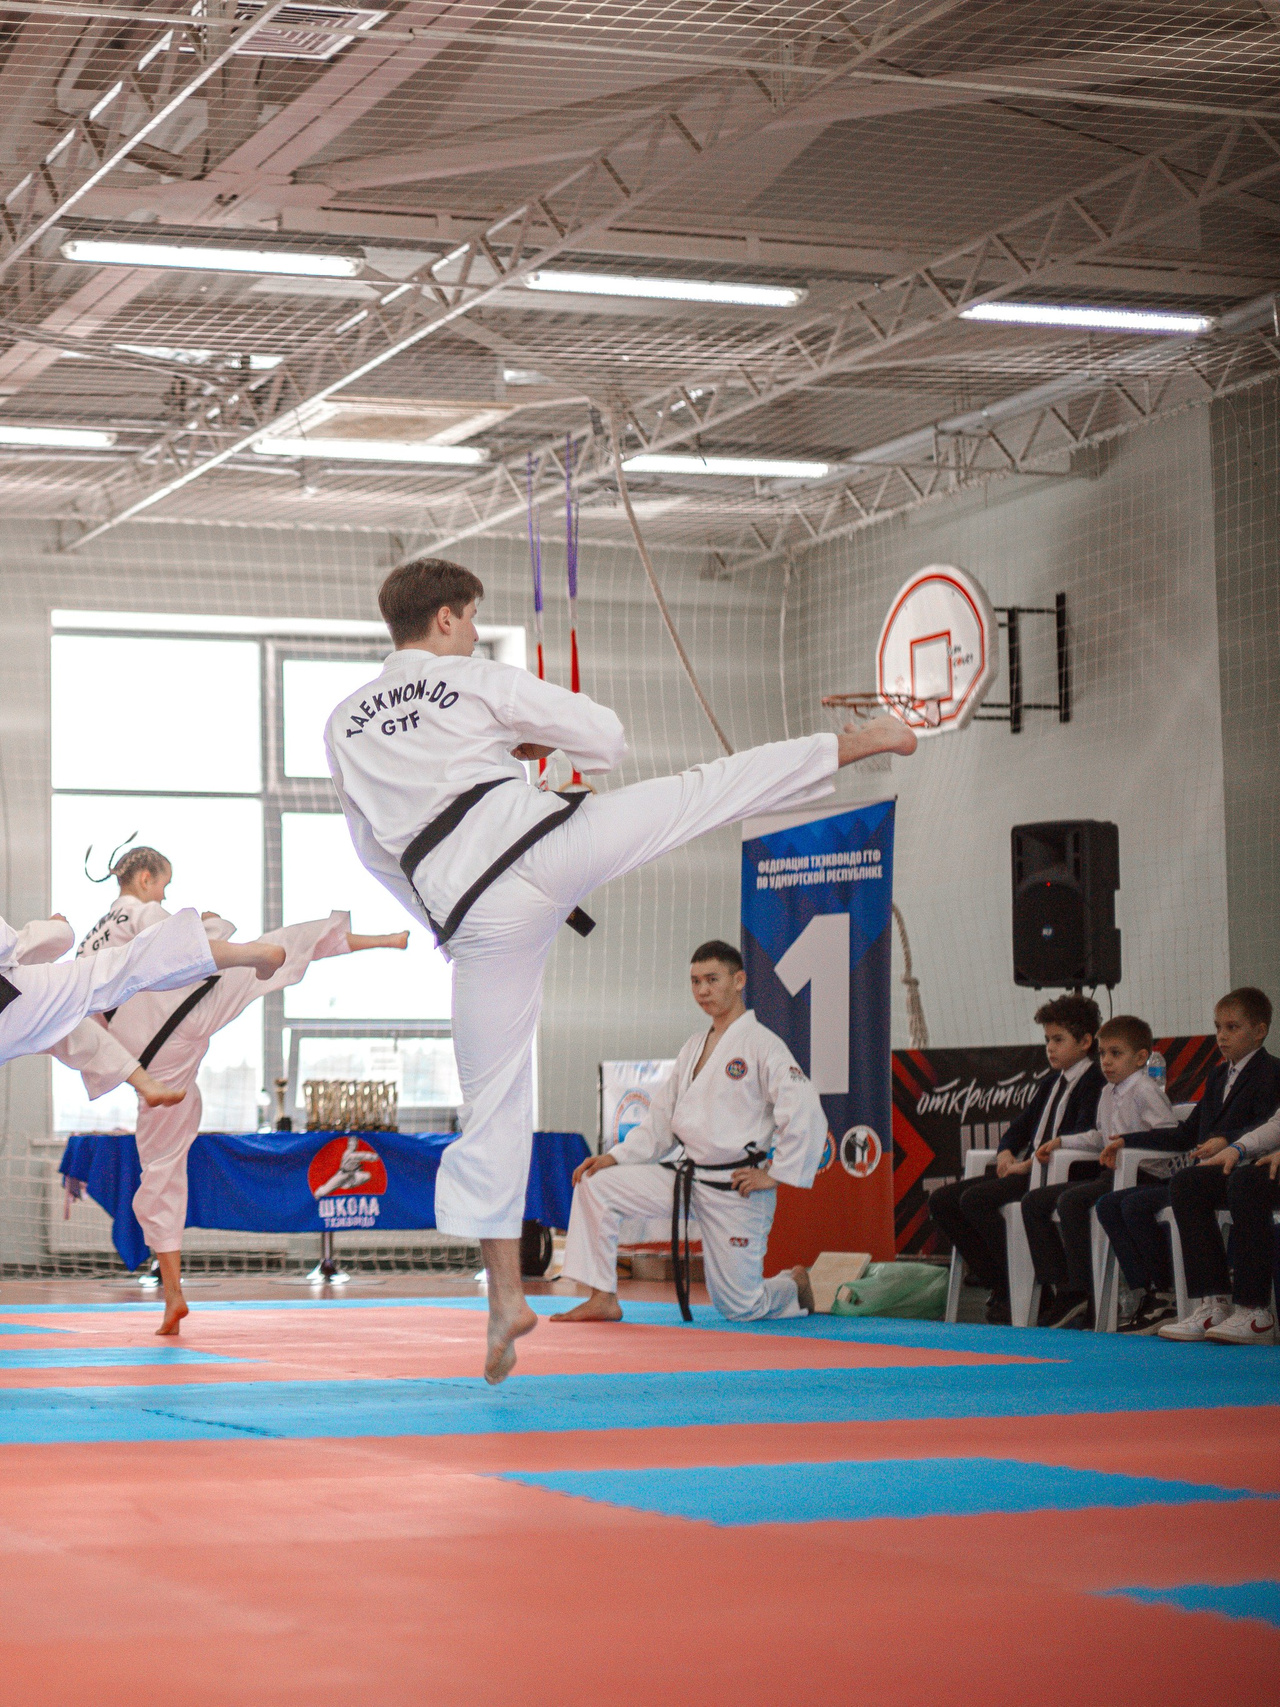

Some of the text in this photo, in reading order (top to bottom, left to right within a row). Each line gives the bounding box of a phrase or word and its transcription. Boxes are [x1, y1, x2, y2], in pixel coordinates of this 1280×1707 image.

[346, 679, 460, 738] TAEKWON-DO
[381, 709, 420, 736] GTF
[774, 912, 850, 1095] 1
[319, 1196, 380, 1218] ШКОЛА
